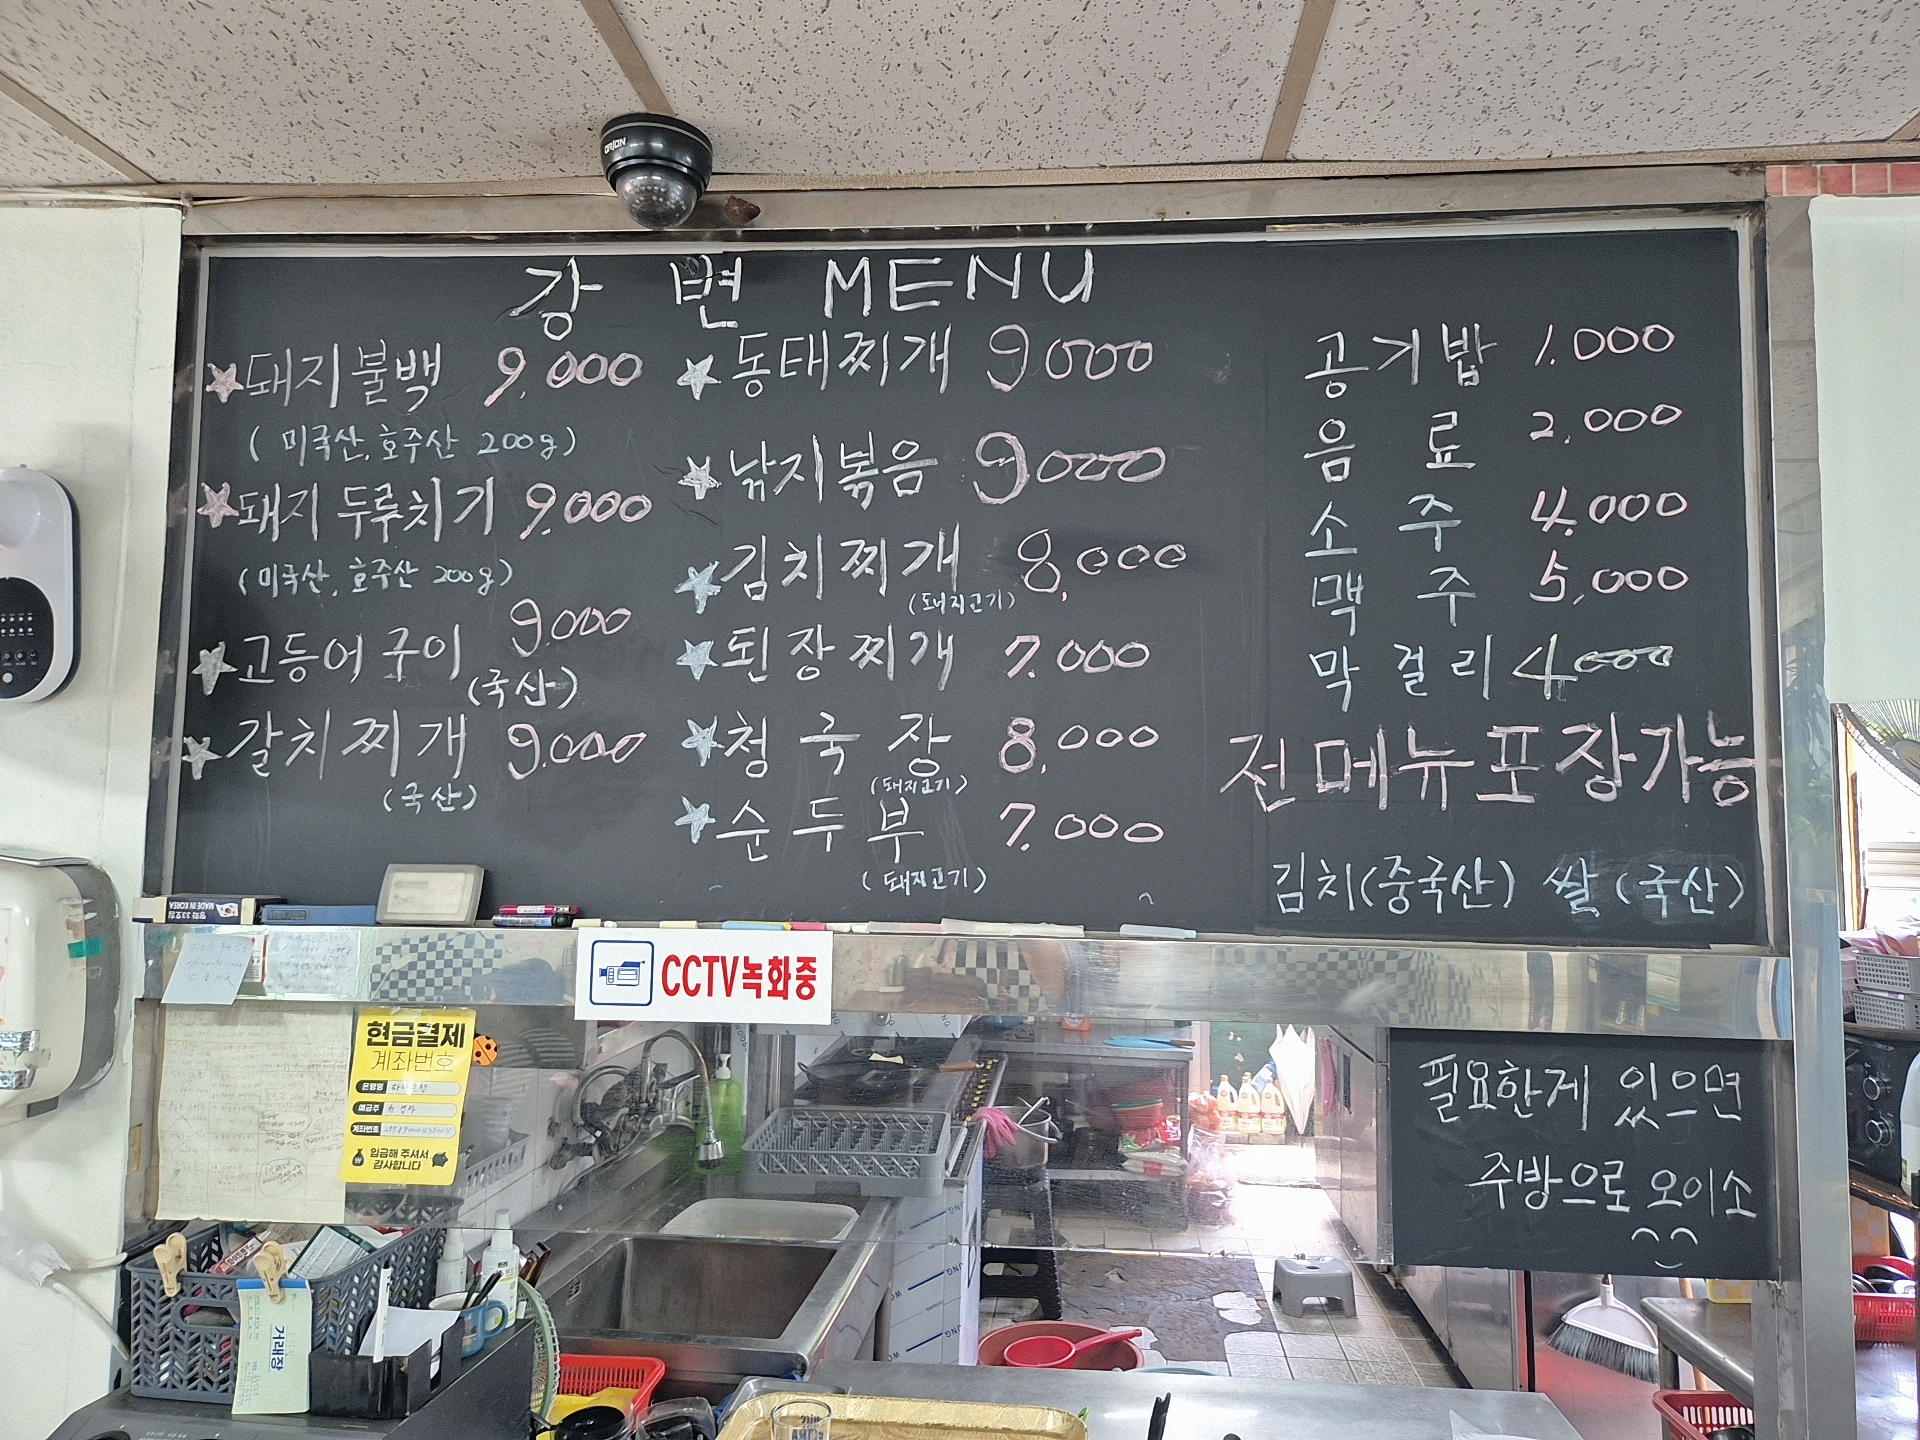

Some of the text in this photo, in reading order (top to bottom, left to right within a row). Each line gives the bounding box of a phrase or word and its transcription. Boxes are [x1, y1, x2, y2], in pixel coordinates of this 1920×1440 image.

[824, 248, 1095, 318] MENU
[247, 339, 440, 412] 돼지불백
[730, 322, 1152, 397] 동태찌개 9000
[1305, 323, 1497, 398] 공기밥
[973, 432, 1165, 504] 9000
[722, 522, 960, 601] 김치찌개
[239, 634, 362, 683] 고등어
[383, 624, 460, 682] 구이
[722, 623, 953, 690] 된장찌개
[1512, 634, 1673, 700] 4000
[168, 901, 215, 910] MADE IN KOREA
[1543, 858, 1600, 917] 쌀
[661, 954, 818, 1001] CCTV녹화중
[366, 1020, 466, 1048] 현금결제
[371, 1050, 455, 1072] 계좌번호
[358, 1103, 380, 1112] 예금주
[362, 1082, 385, 1092] 은행명
[1419, 1054, 1741, 1131] 필요한게 있으면
[352, 1123, 380, 1133] 계좌번호
[370, 1148, 430, 1159] 입금해 주셔서
[373, 1160, 422, 1171] 감사합니다
[1465, 1152, 1756, 1218] 주방으로 오이소
[270, 1325, 287, 1373] 거래장
